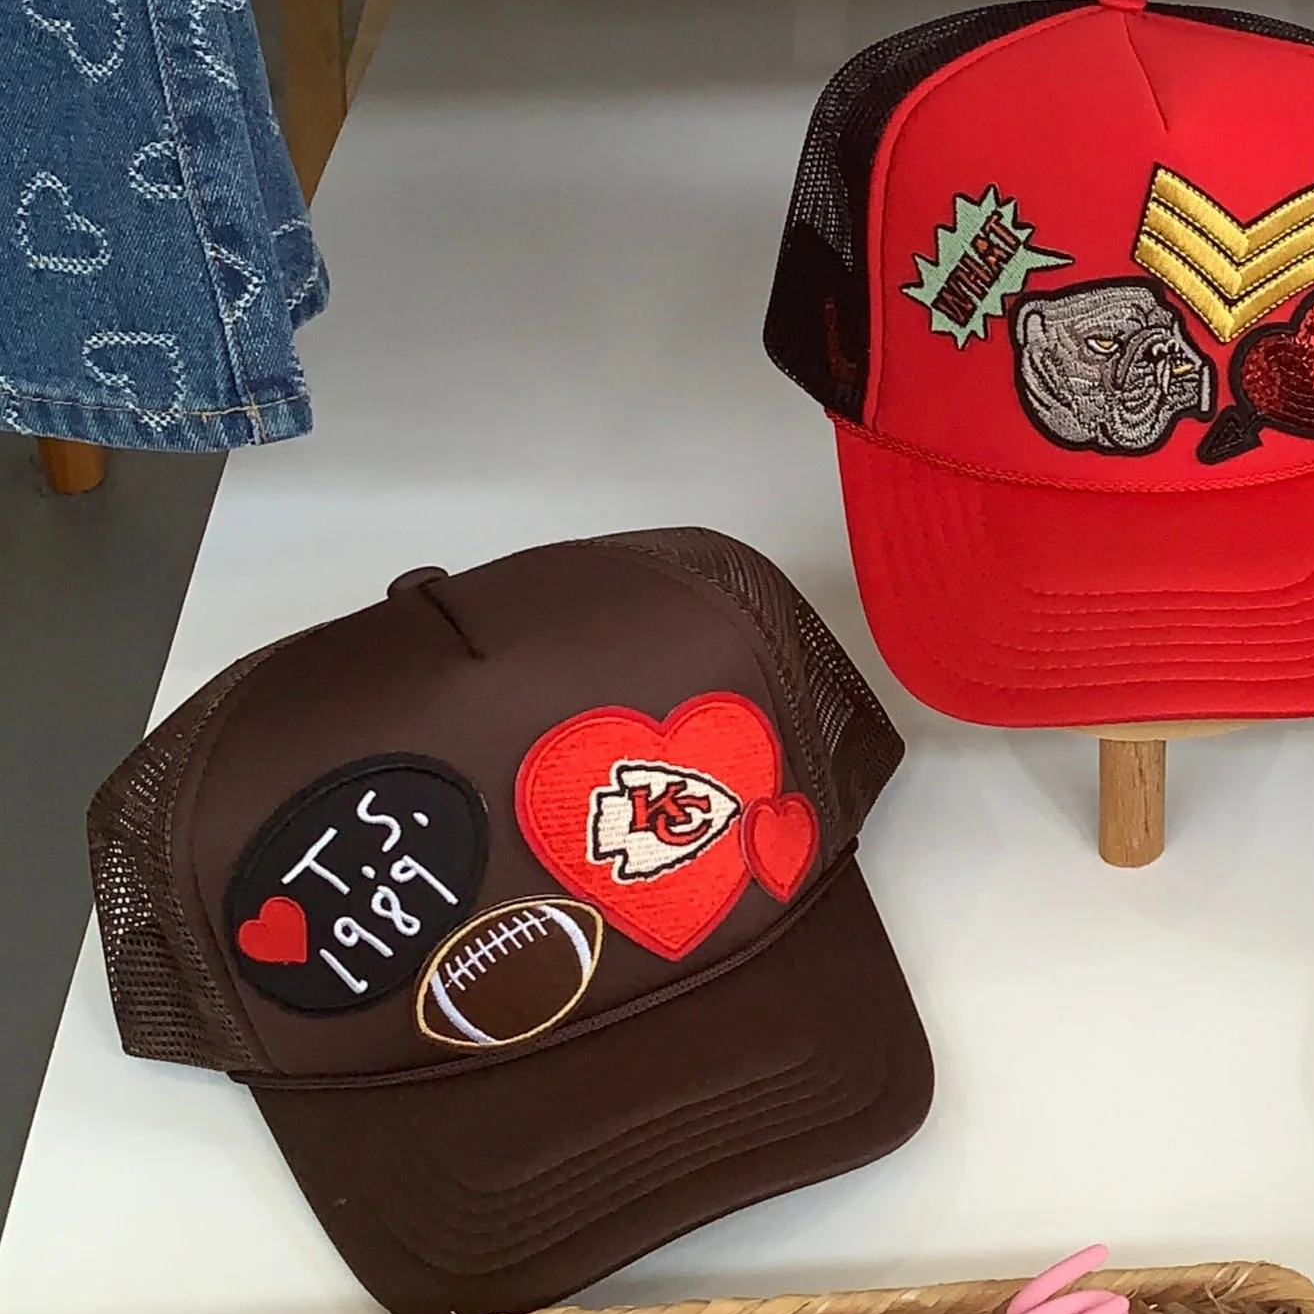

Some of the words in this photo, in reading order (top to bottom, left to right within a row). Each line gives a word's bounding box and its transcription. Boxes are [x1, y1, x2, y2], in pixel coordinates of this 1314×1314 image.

[931, 209, 1022, 328] WHAT
[628, 780, 713, 846] KC
[319, 854, 459, 994] 1989
